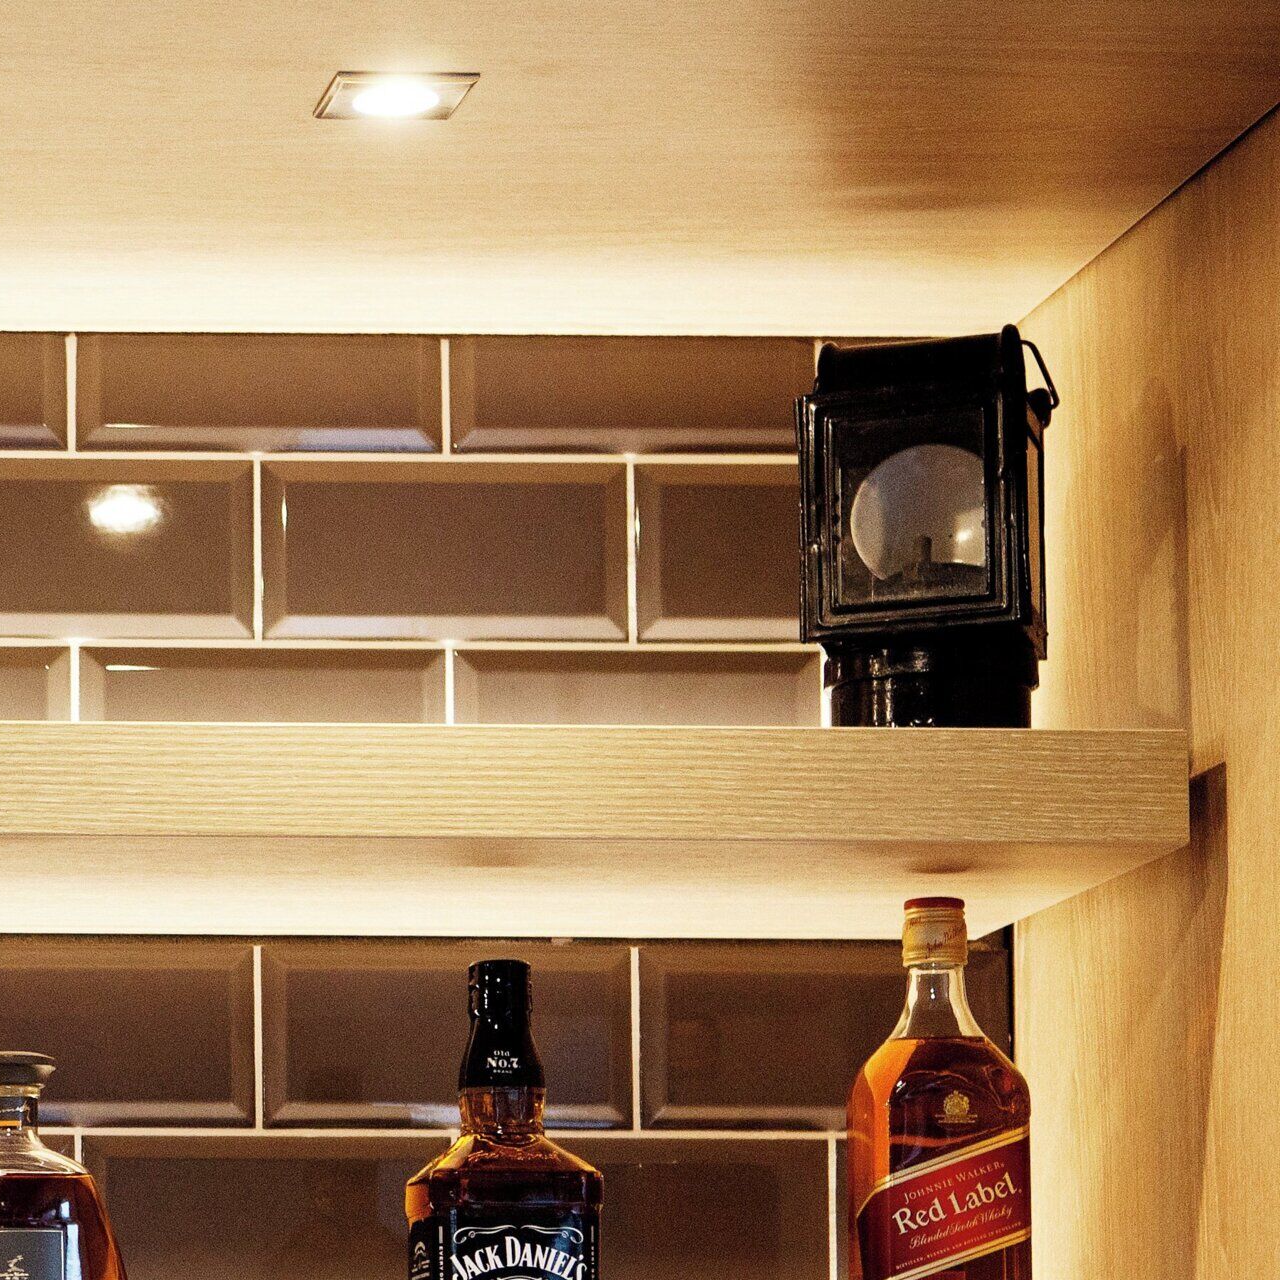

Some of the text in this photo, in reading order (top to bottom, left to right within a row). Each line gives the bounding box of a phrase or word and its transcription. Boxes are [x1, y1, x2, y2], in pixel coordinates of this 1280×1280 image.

[486, 1057, 519, 1068] No.7
[903, 1161, 1001, 1205] JOHNNIE WALKER
[891, 1197, 948, 1235] Red
[909, 1206, 1013, 1249] Blended Scotch Whisky
